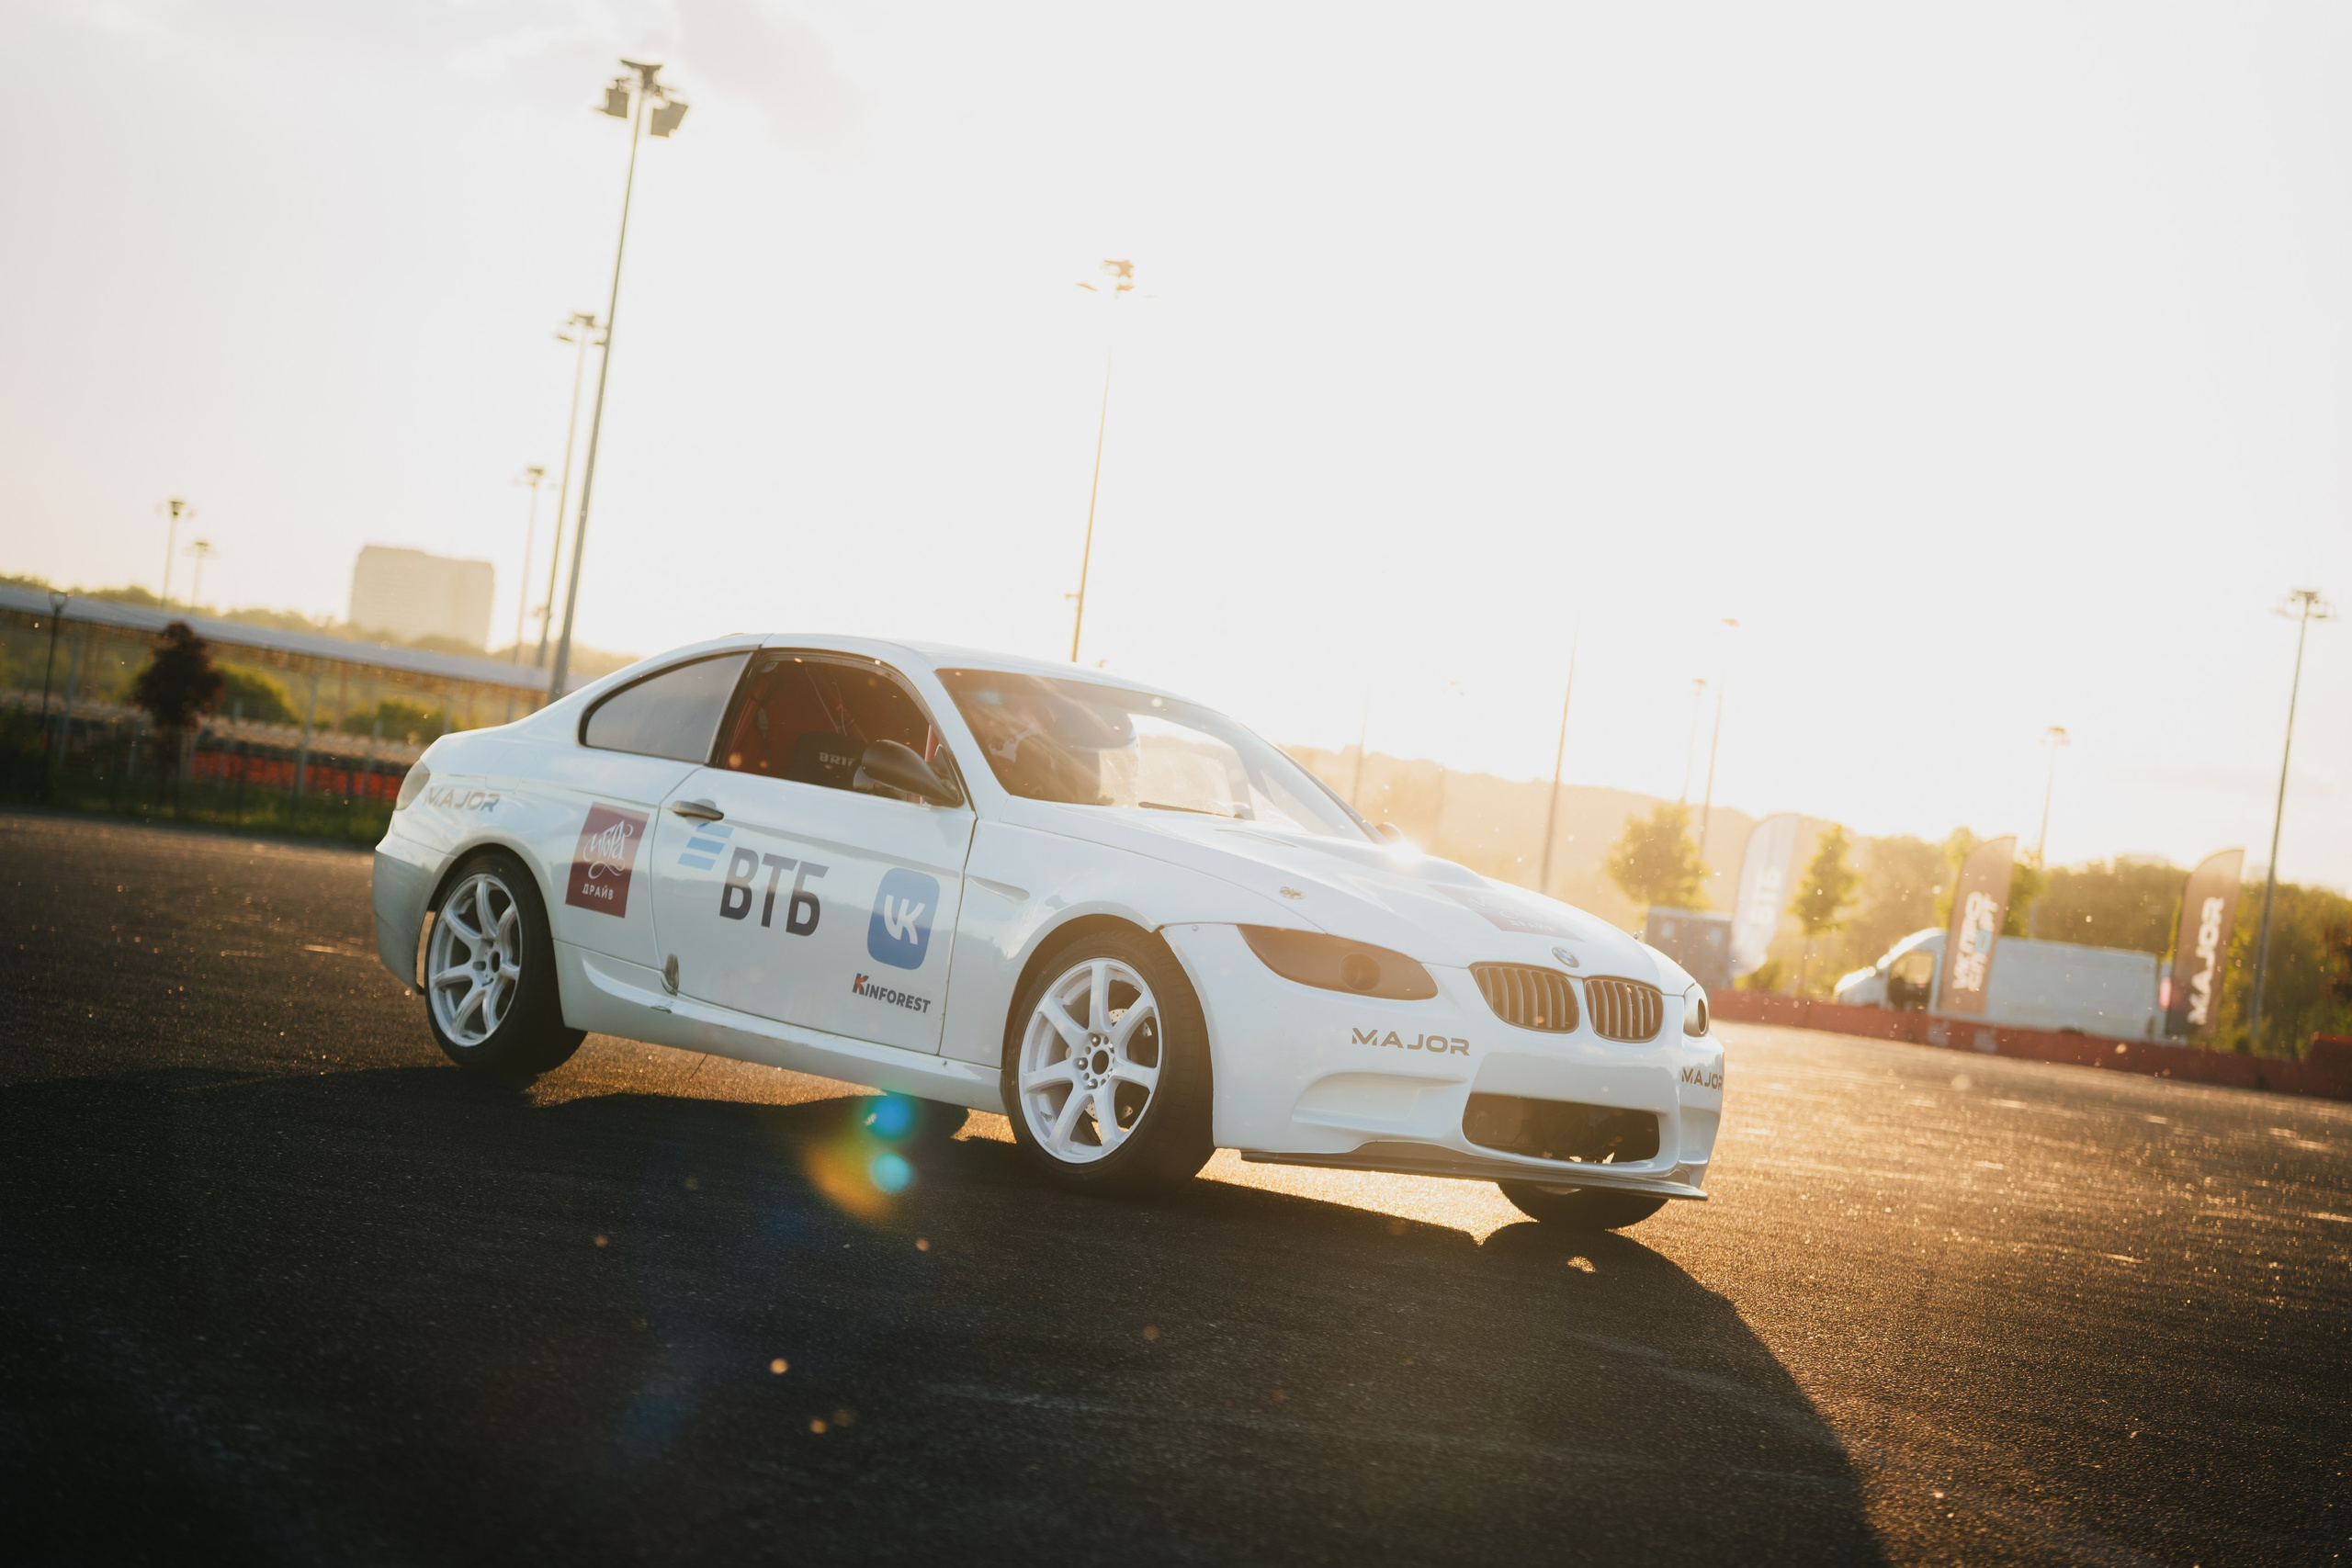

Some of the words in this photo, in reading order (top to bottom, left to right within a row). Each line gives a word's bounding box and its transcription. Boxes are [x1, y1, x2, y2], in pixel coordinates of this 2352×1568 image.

[424, 787, 500, 812] MAJOR
[582, 884, 614, 900] ДРАЙВ
[719, 846, 829, 937] ВТБ
[883, 894, 925, 945] VK
[2187, 896, 2224, 1026] MAJOR
[852, 973, 931, 1013] KINFOREST
[1351, 1027, 1470, 1056] MAJOR
[1681, 1066, 1723, 1091] MAJOR
